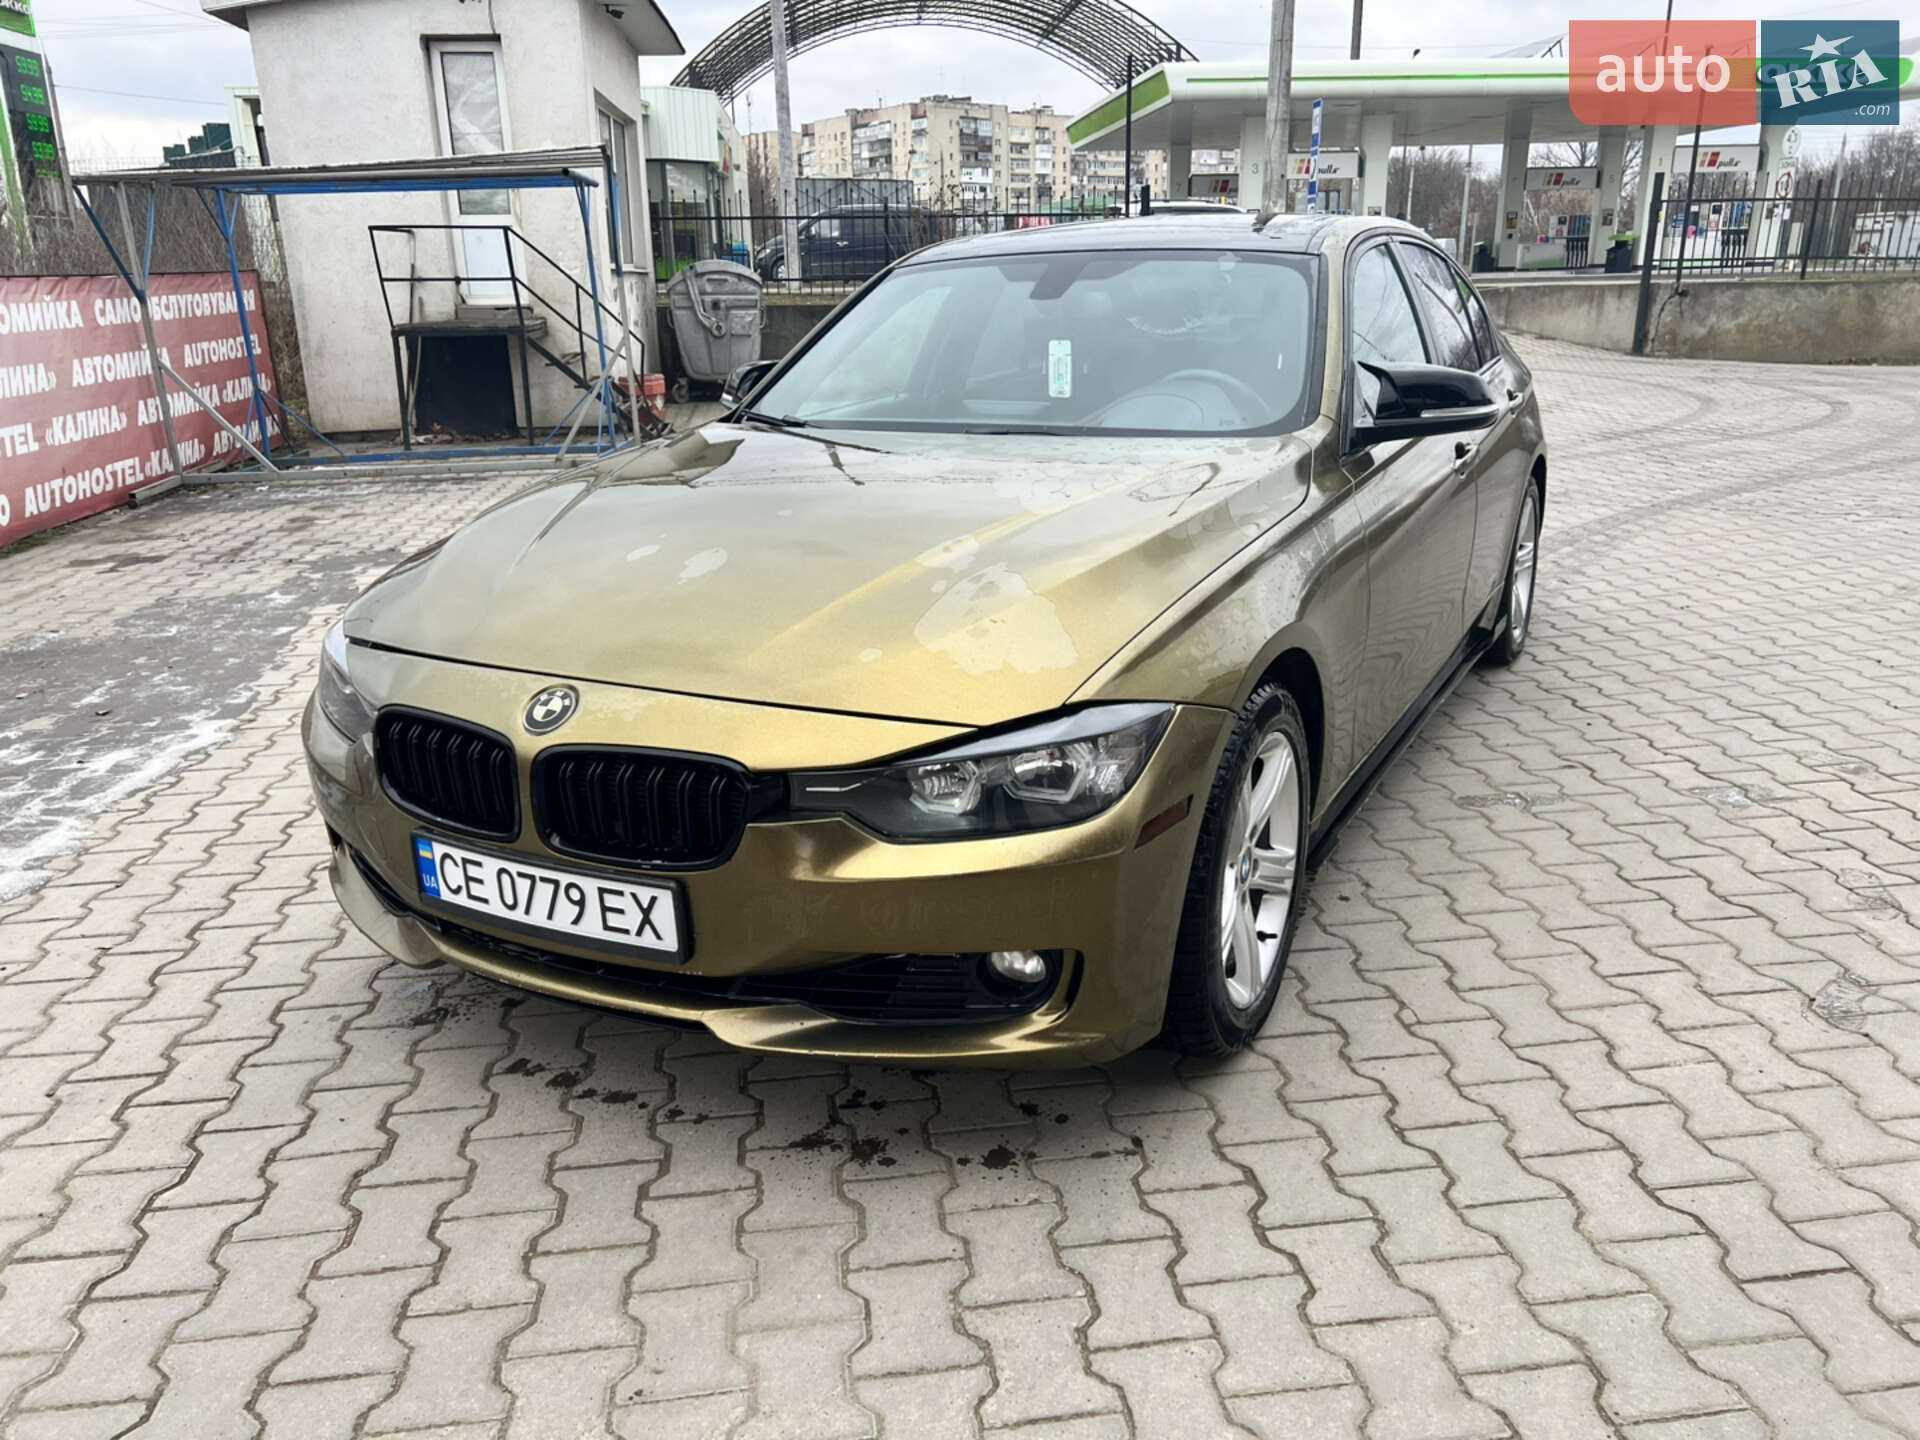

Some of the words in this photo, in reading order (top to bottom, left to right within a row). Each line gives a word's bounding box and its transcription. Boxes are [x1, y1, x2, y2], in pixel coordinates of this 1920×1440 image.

[1251, 162, 1259, 174] 3
[45, 405, 128, 446] «КАЛИНА»
[25, 456, 144, 518] AUTOHOSTEL
[423, 873, 438, 890] UA
[439, 852, 490, 905] CE
[495, 866, 586, 926] 0779
[597, 886, 663, 941] EX
